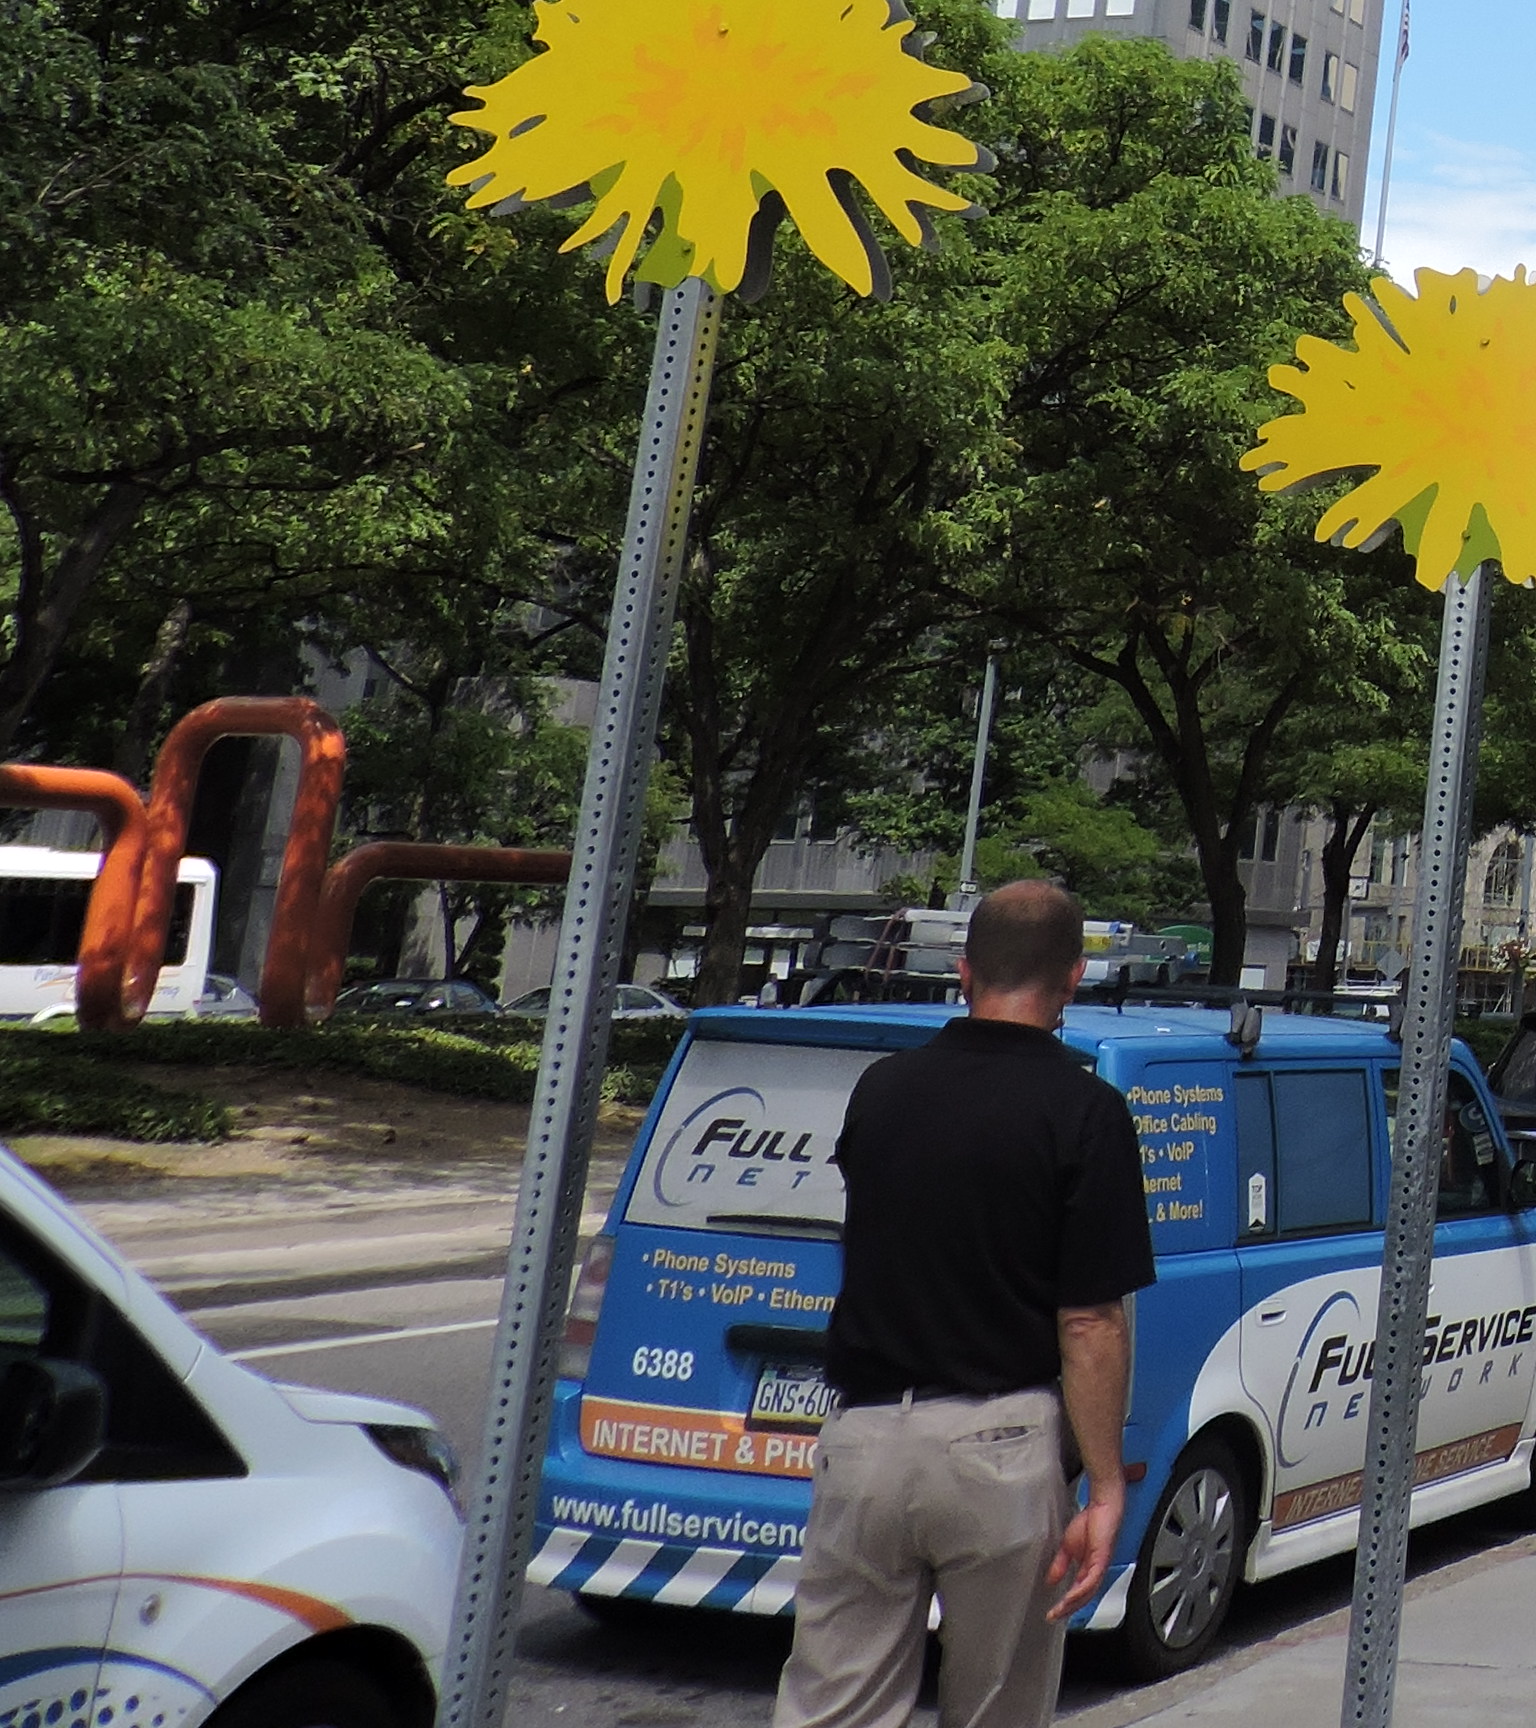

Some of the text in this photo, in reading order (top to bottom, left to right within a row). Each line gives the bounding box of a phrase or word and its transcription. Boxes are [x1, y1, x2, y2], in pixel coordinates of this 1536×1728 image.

[1132, 1084, 1224, 1108] Phone Systems
[1170, 1112, 1217, 1135] Cabling
[691, 1118, 813, 1163] FULL
[1166, 1141, 1195, 1162] VoIP
[1143, 1172, 1182, 1193] hernet
[1155, 1199, 1203, 1222] & More!
[653, 1248, 796, 1279] Phone Systems
[658, 1279, 836, 1313] T1's VoIP Ethern
[632, 1345, 695, 1381] 6388
[592, 1419, 728, 1462] INTERNET
[734, 1435, 756, 1465] &
[1284, 1476, 1361, 1522] INTERNE
[1433, 1434, 1497, 1473] SERVICE
